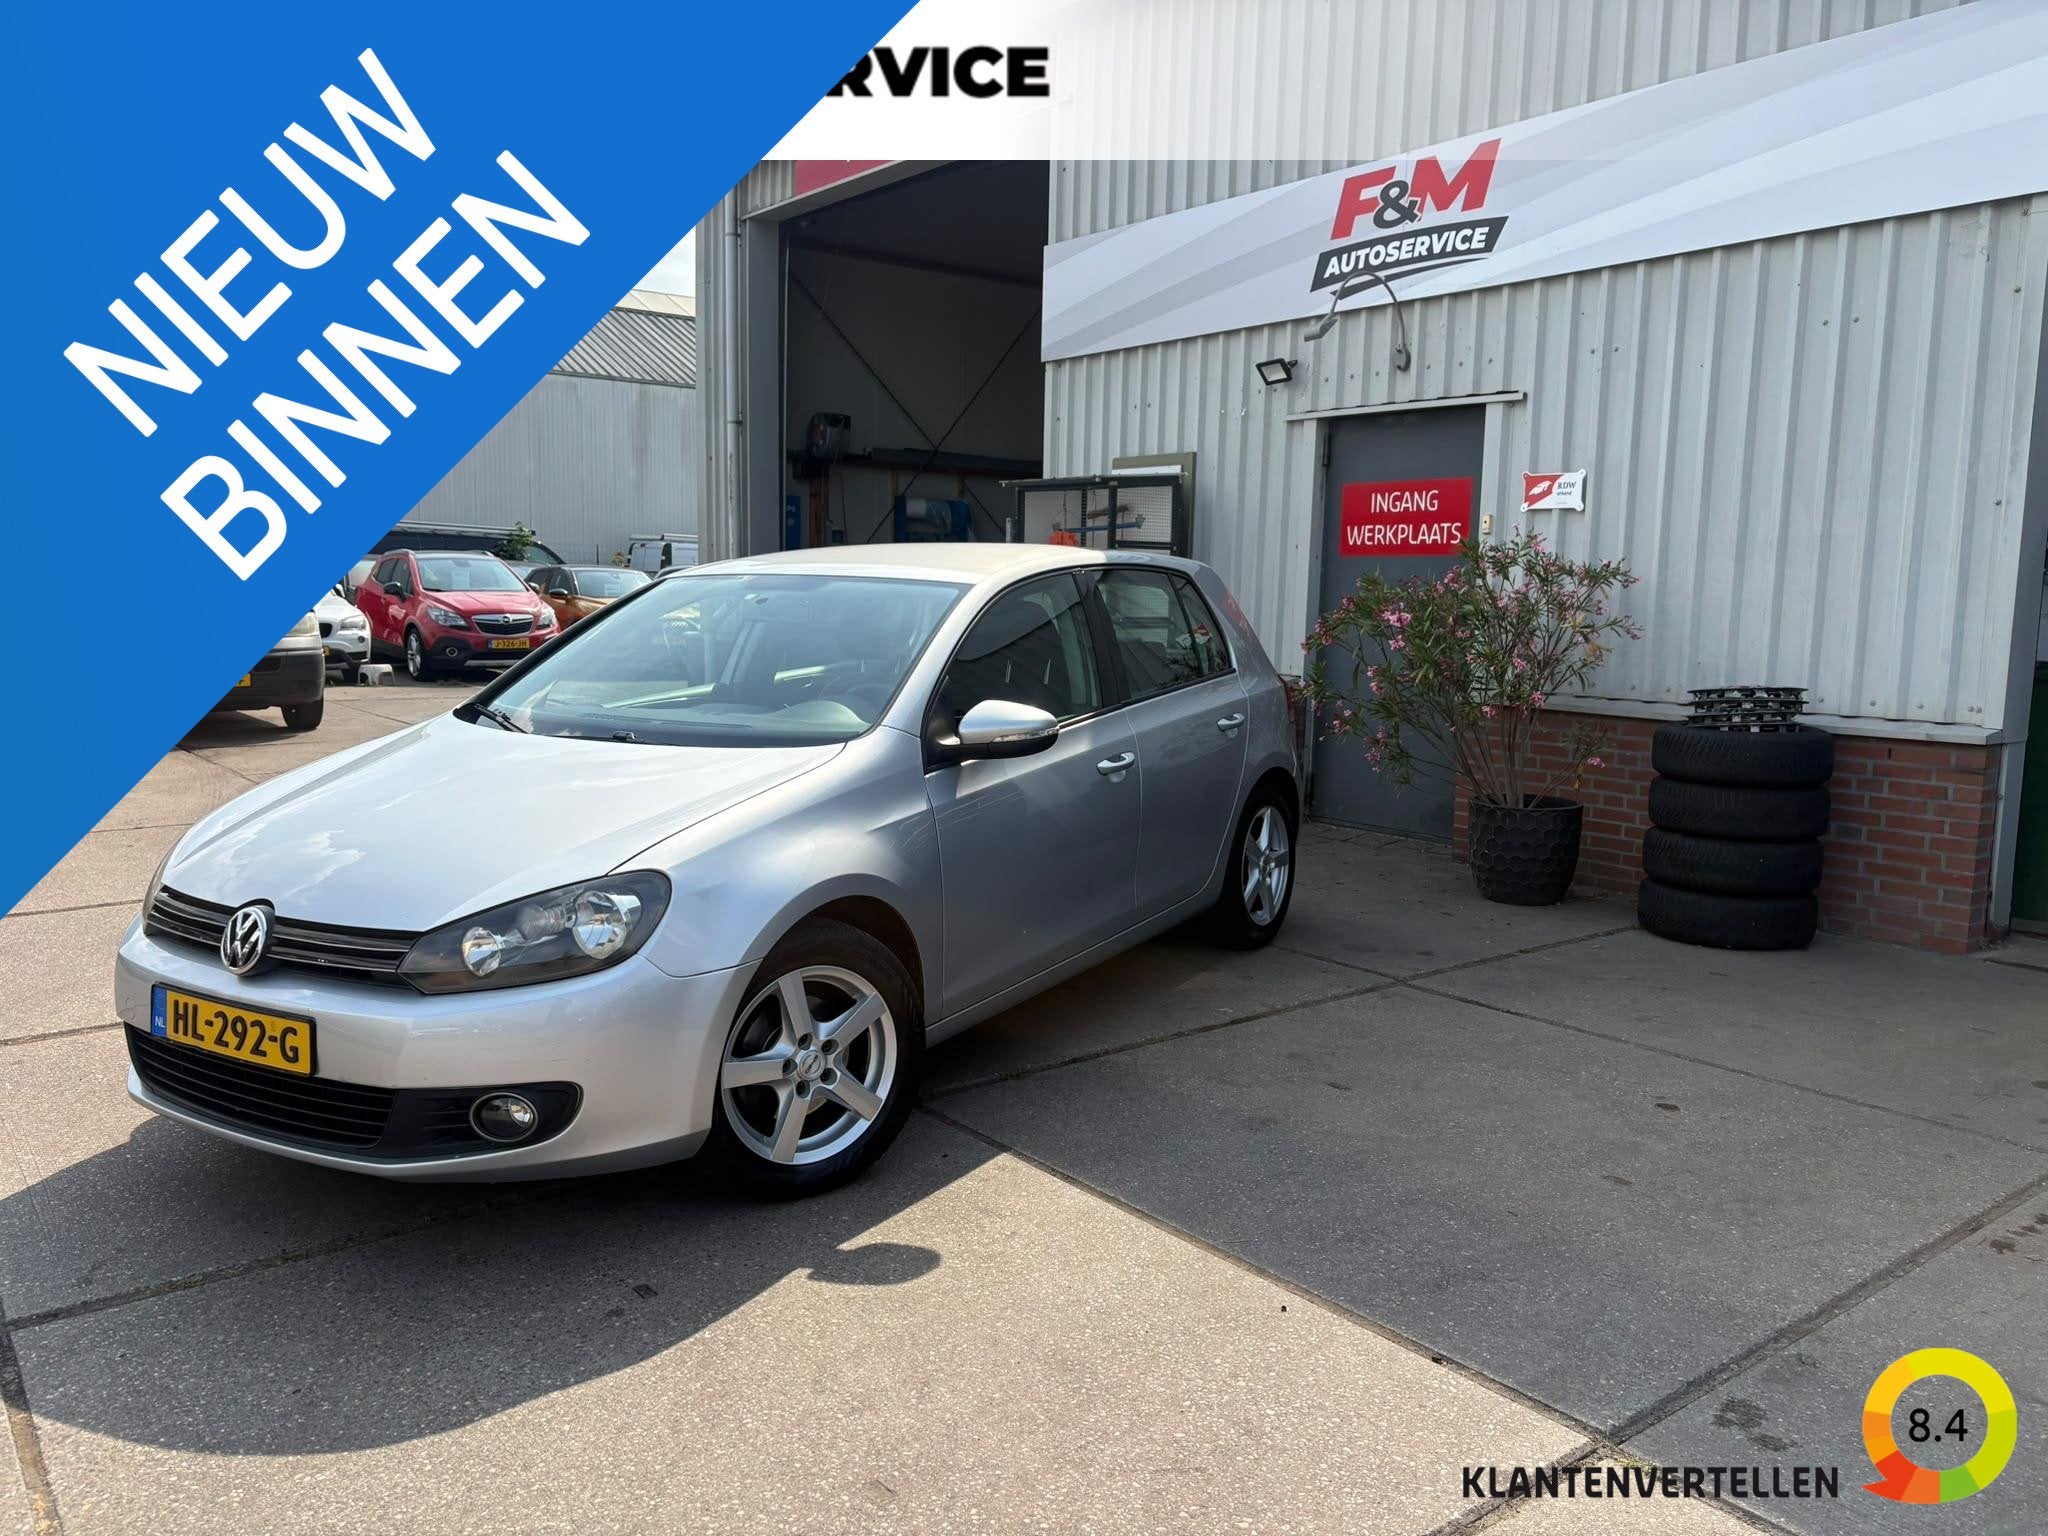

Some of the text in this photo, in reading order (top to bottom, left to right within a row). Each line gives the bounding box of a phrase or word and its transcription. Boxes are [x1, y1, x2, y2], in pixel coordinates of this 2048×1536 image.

[1330, 138, 1502, 240] F&M
[1323, 227, 1490, 279] AUTOSERVICE
[1370, 489, 1439, 514] INGANG
[1557, 481, 1576, 490] RDW
[1346, 522, 1462, 546] WERKPLAATS
[154, 999, 300, 1064] NL HL-292-G
